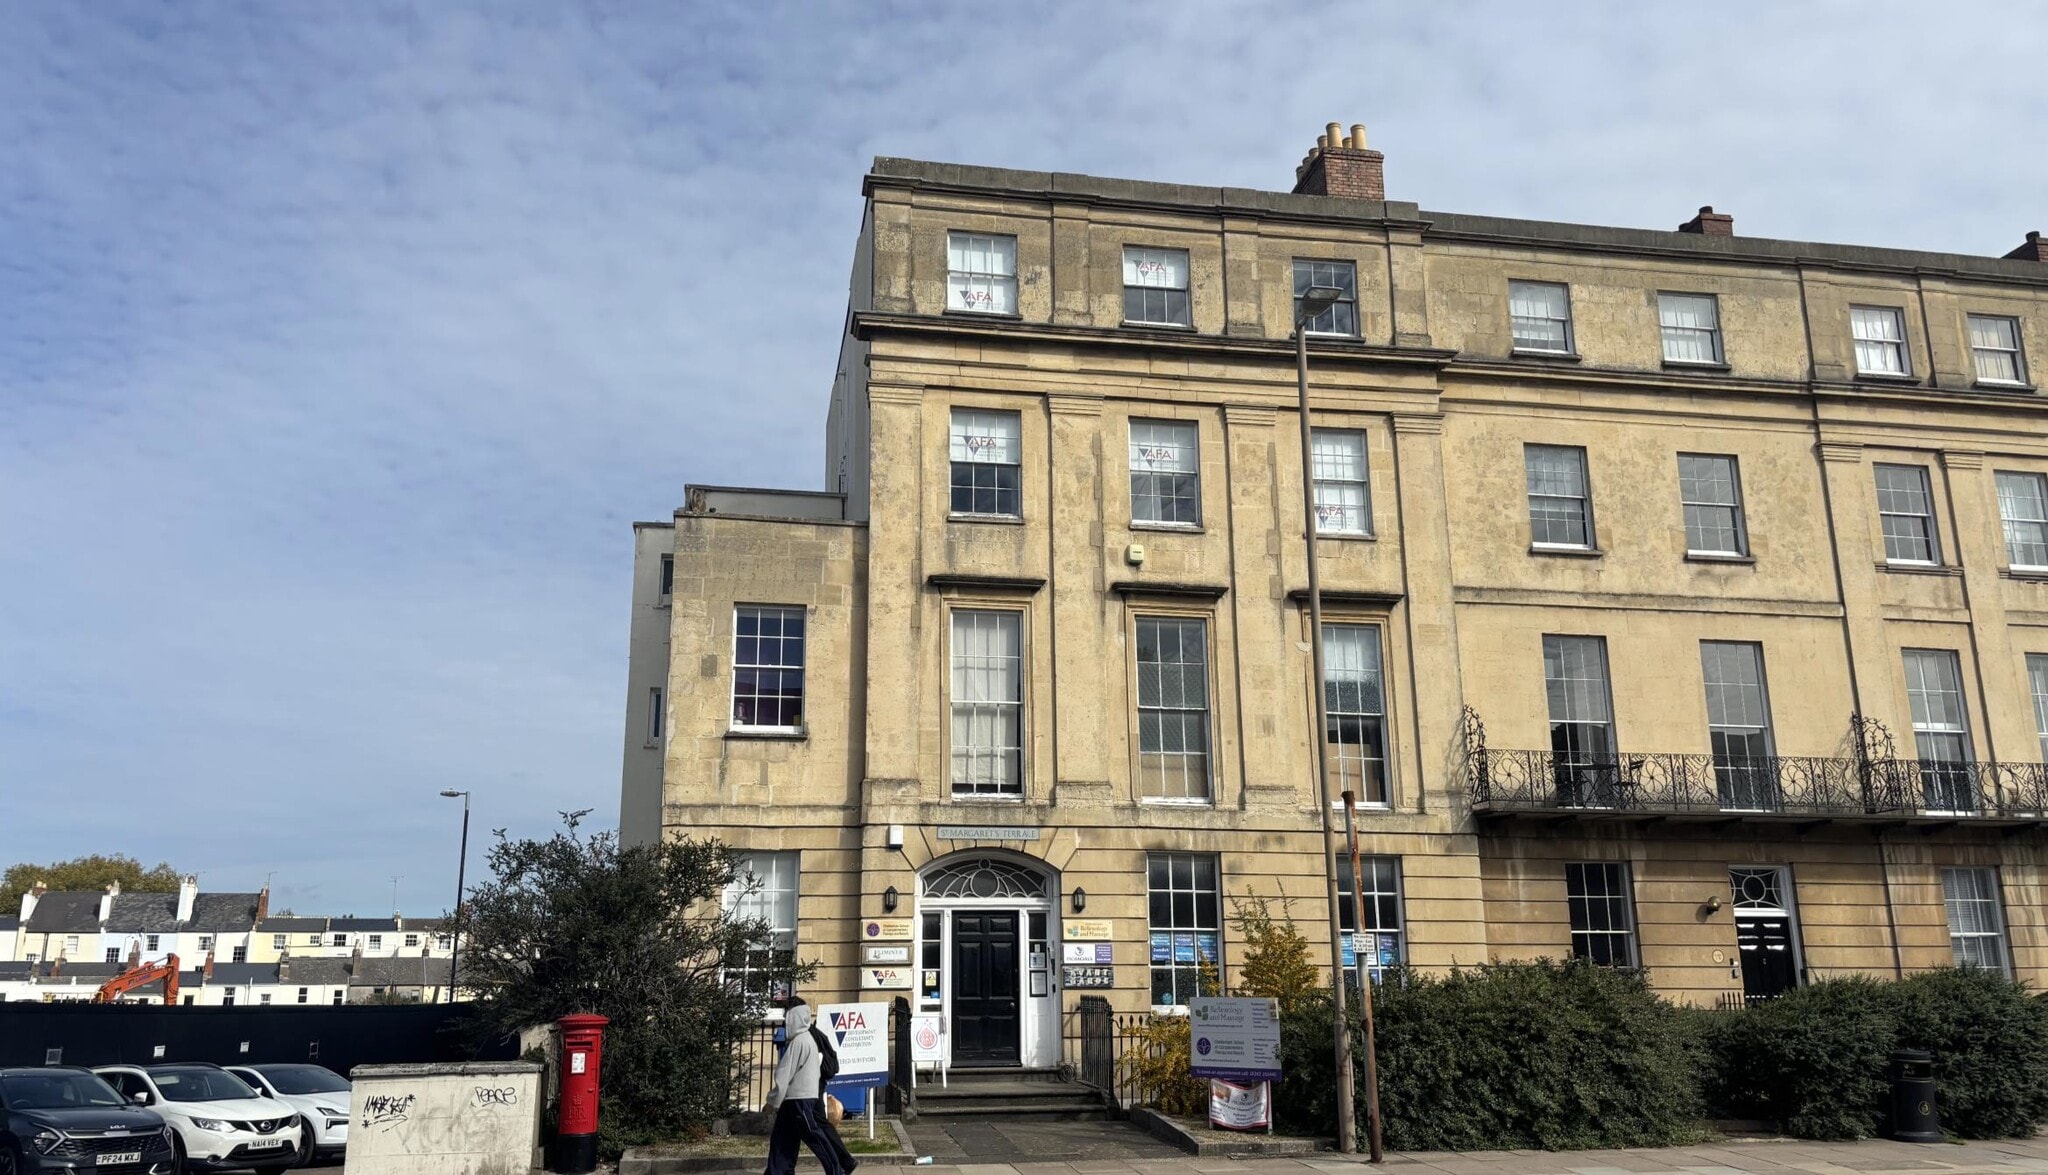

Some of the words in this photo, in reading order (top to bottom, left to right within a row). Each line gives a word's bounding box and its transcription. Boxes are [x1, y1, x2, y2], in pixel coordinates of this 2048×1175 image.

[1140, 261, 1165, 271] AFA
[966, 291, 992, 302] AFA
[968, 436, 996, 448] AFA
[1145, 448, 1172, 459] AFA
[878, 970, 896, 978] AFA
[835, 1012, 866, 1030] AFA
[251, 1140, 266, 1148] NA14
[267, 1139, 280, 1147] VEX
[102, 1154, 122, 1163] PF24
[123, 1153, 140, 1162] MXJ
